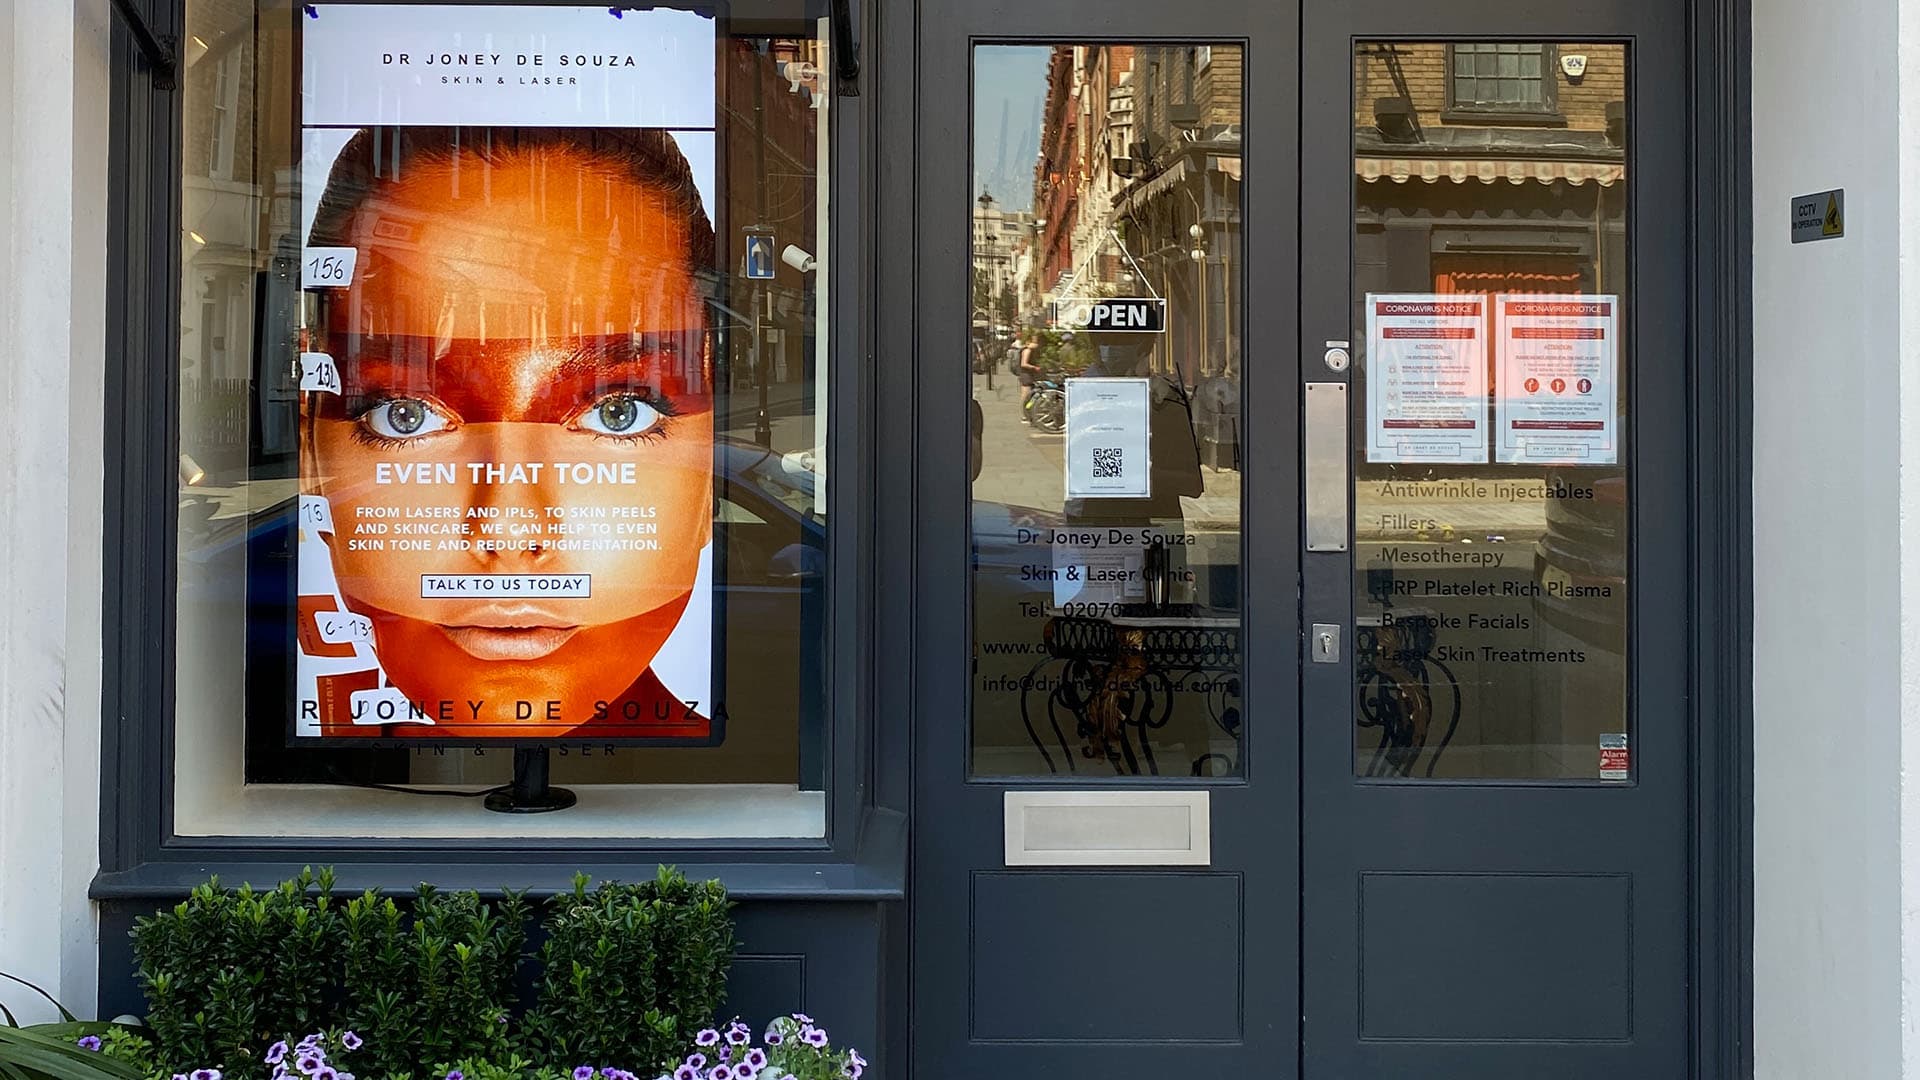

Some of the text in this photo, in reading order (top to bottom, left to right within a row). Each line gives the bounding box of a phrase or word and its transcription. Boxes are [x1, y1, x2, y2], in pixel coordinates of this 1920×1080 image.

[382, 53, 637, 67] DR JONEY DE SOUZA
[441, 76, 578, 85] SKIN & LASER
[1799, 203, 1817, 217] CCTV
[309, 256, 343, 280] 156
[1076, 305, 1147, 327] OPEN
[1385, 304, 1473, 313] CORONAVIRUS NOTICE
[1514, 304, 1602, 314] CORONAVIRUS NOTICE
[376, 464, 637, 484] EVEN THAT TONE
[1380, 482, 1593, 502] Antiwrinkle Injectables
[356, 507, 656, 520] FROM LASERS AND IPLs, TO SKIN PEELS
[355, 523, 656, 536] AND SKINCARE, WE CAN HELP TO EVEN
[1382, 515, 1436, 530] Fillers
[349, 539, 662, 551] SKIN TONE AND REDUCE PIGMENTATION.
[1018, 530, 1196, 549] Dr Joney De Souza
[1382, 548, 1504, 567] Mesotherapy
[1021, 565, 1193, 581] Skin & Laser Cnic
[428, 579, 583, 591] TALK TO US TODAY
[1425, 581, 1495, 597] Platelet
[1503, 582, 1540, 597] Rich
[1548, 582, 1611, 597] Plasma
[1018, 602, 1050, 618] Tel:
[1383, 613, 1530, 632] Bespoke Facials
[1437, 646, 1475, 662] Skin
[1482, 647, 1585, 663] Treatments
[302, 701, 319, 719] R
[352, 701, 486, 719] JONEY
[516, 701, 562, 719] DE
[594, 701, 730, 720] SOUZA
[371, 743, 617, 756] SKIN & LASER
